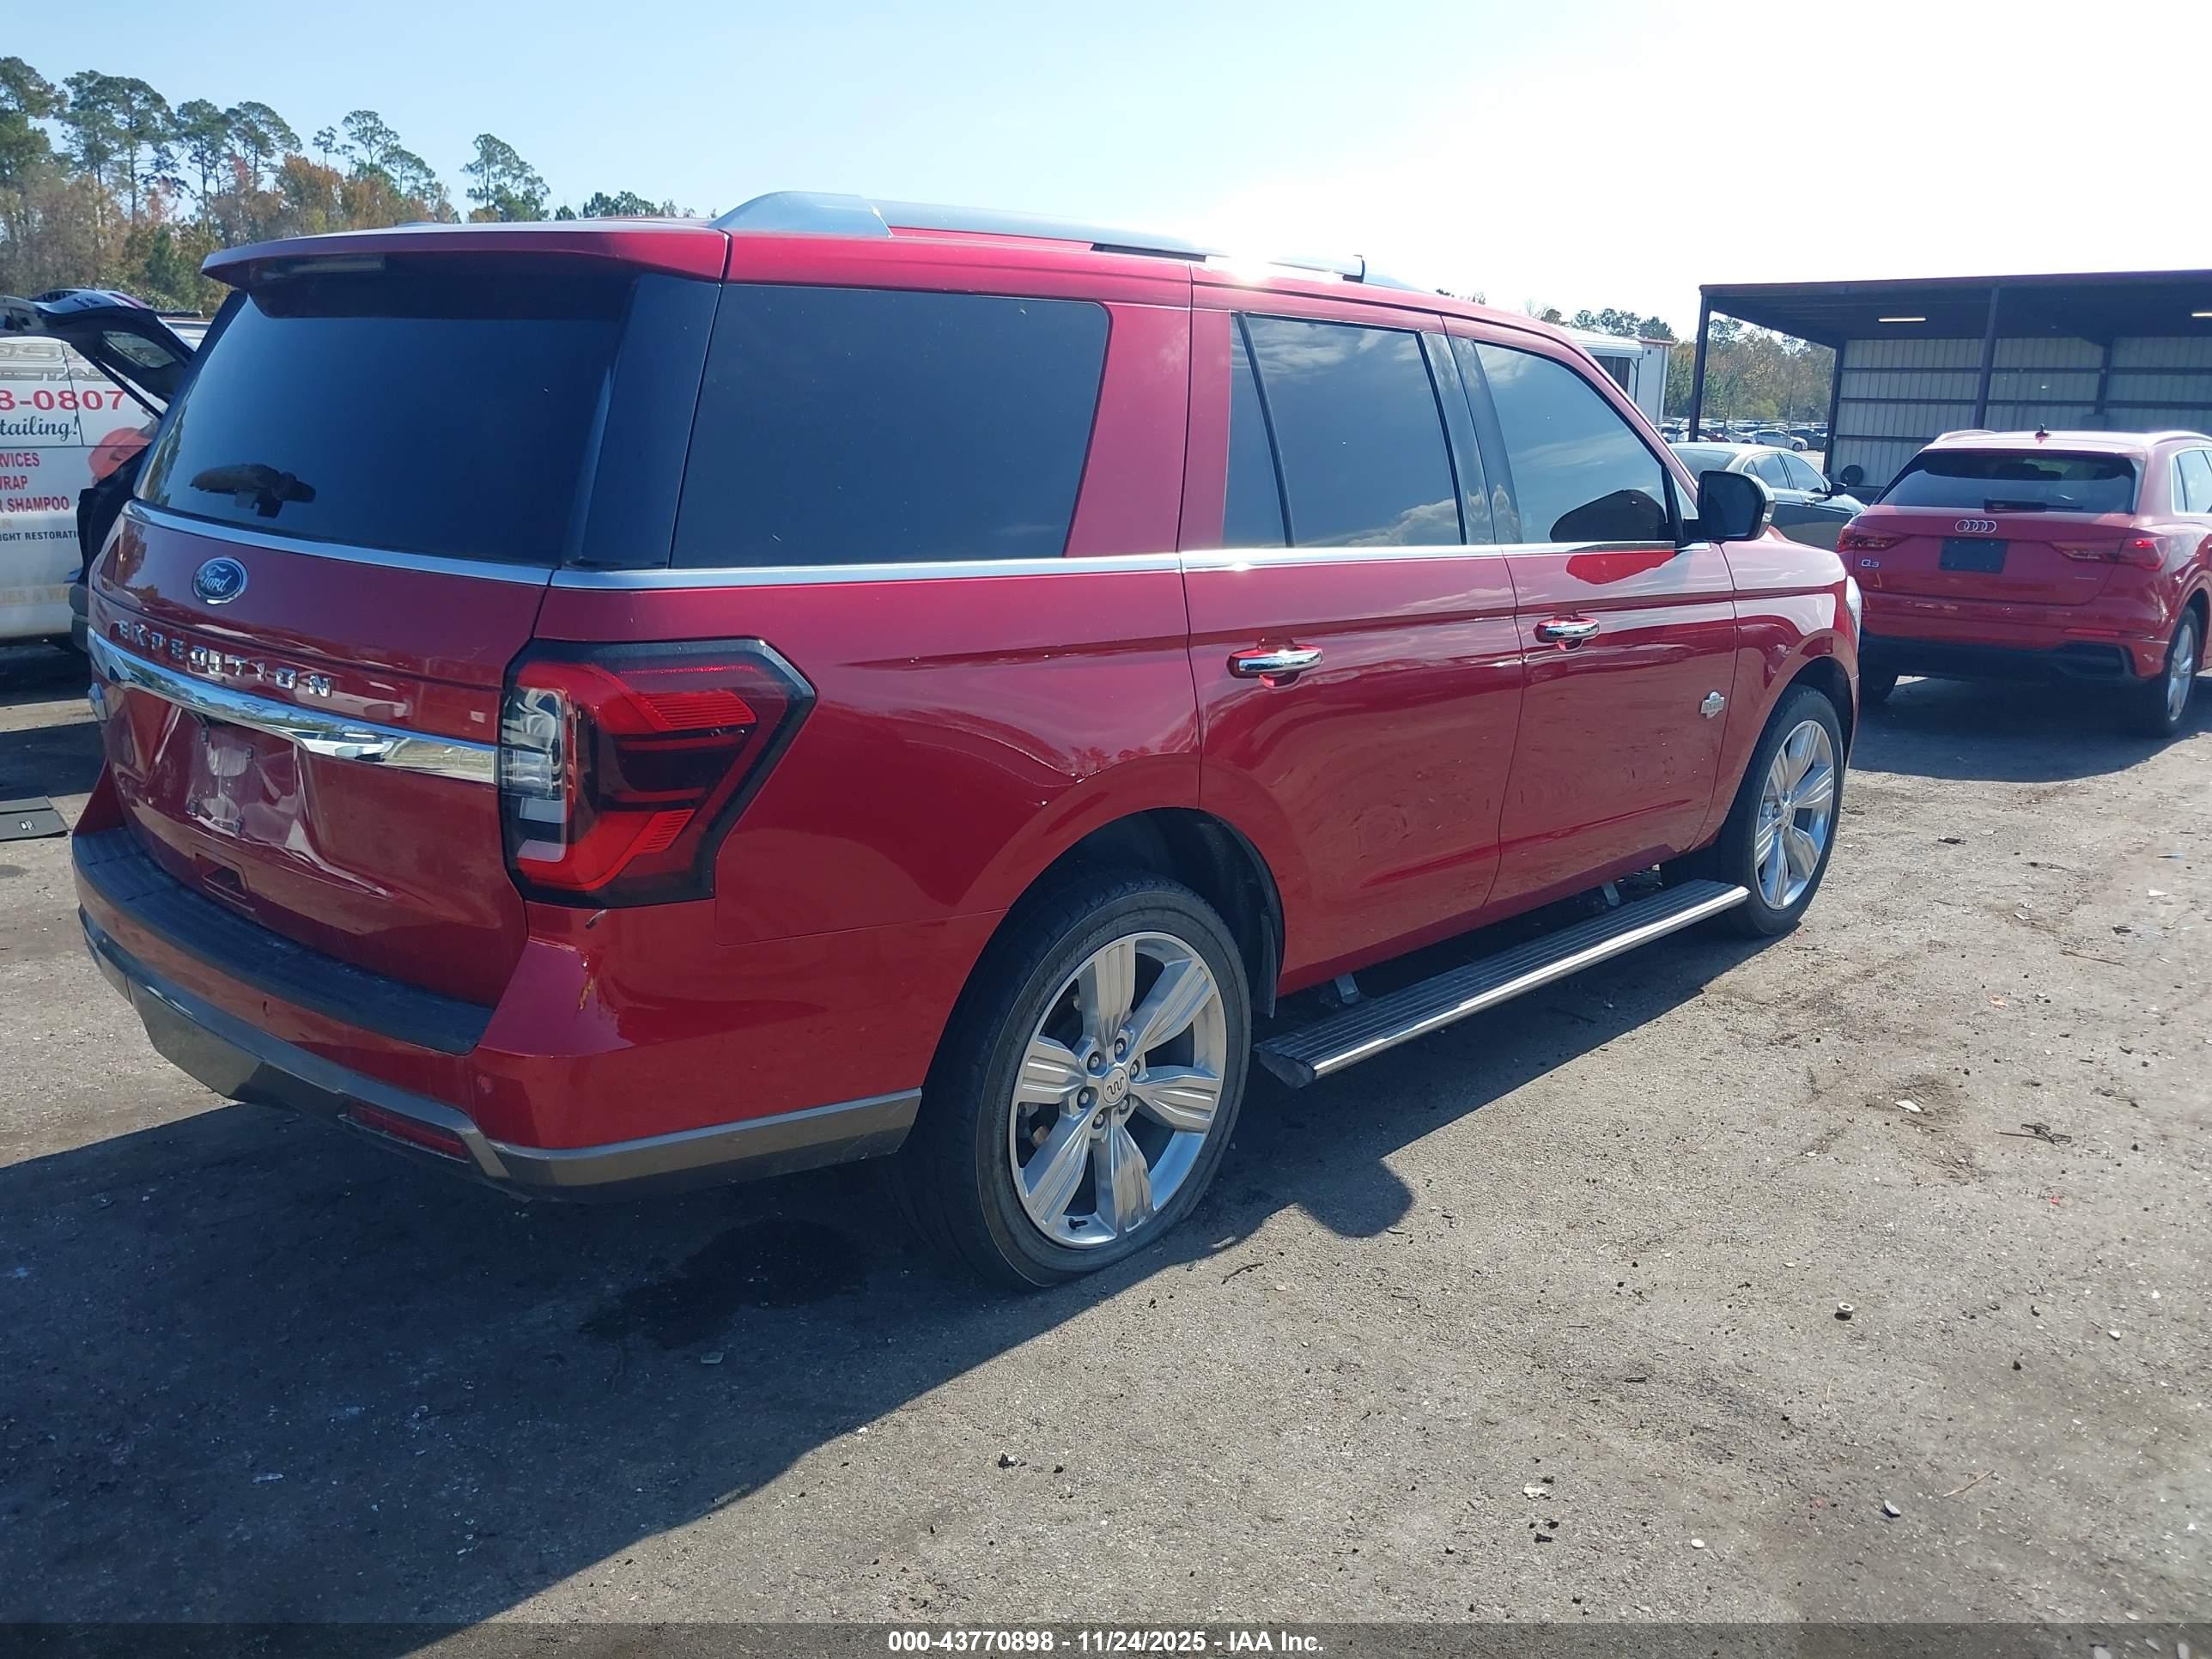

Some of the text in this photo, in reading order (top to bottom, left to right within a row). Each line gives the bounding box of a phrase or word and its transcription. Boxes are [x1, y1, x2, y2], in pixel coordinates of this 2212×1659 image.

[0, 475, 28, 490] RAP
[7, 496, 70, 513] SHAMPOO
[201, 564, 233, 592] Ford
[118, 618, 332, 698] EXPEDITION
